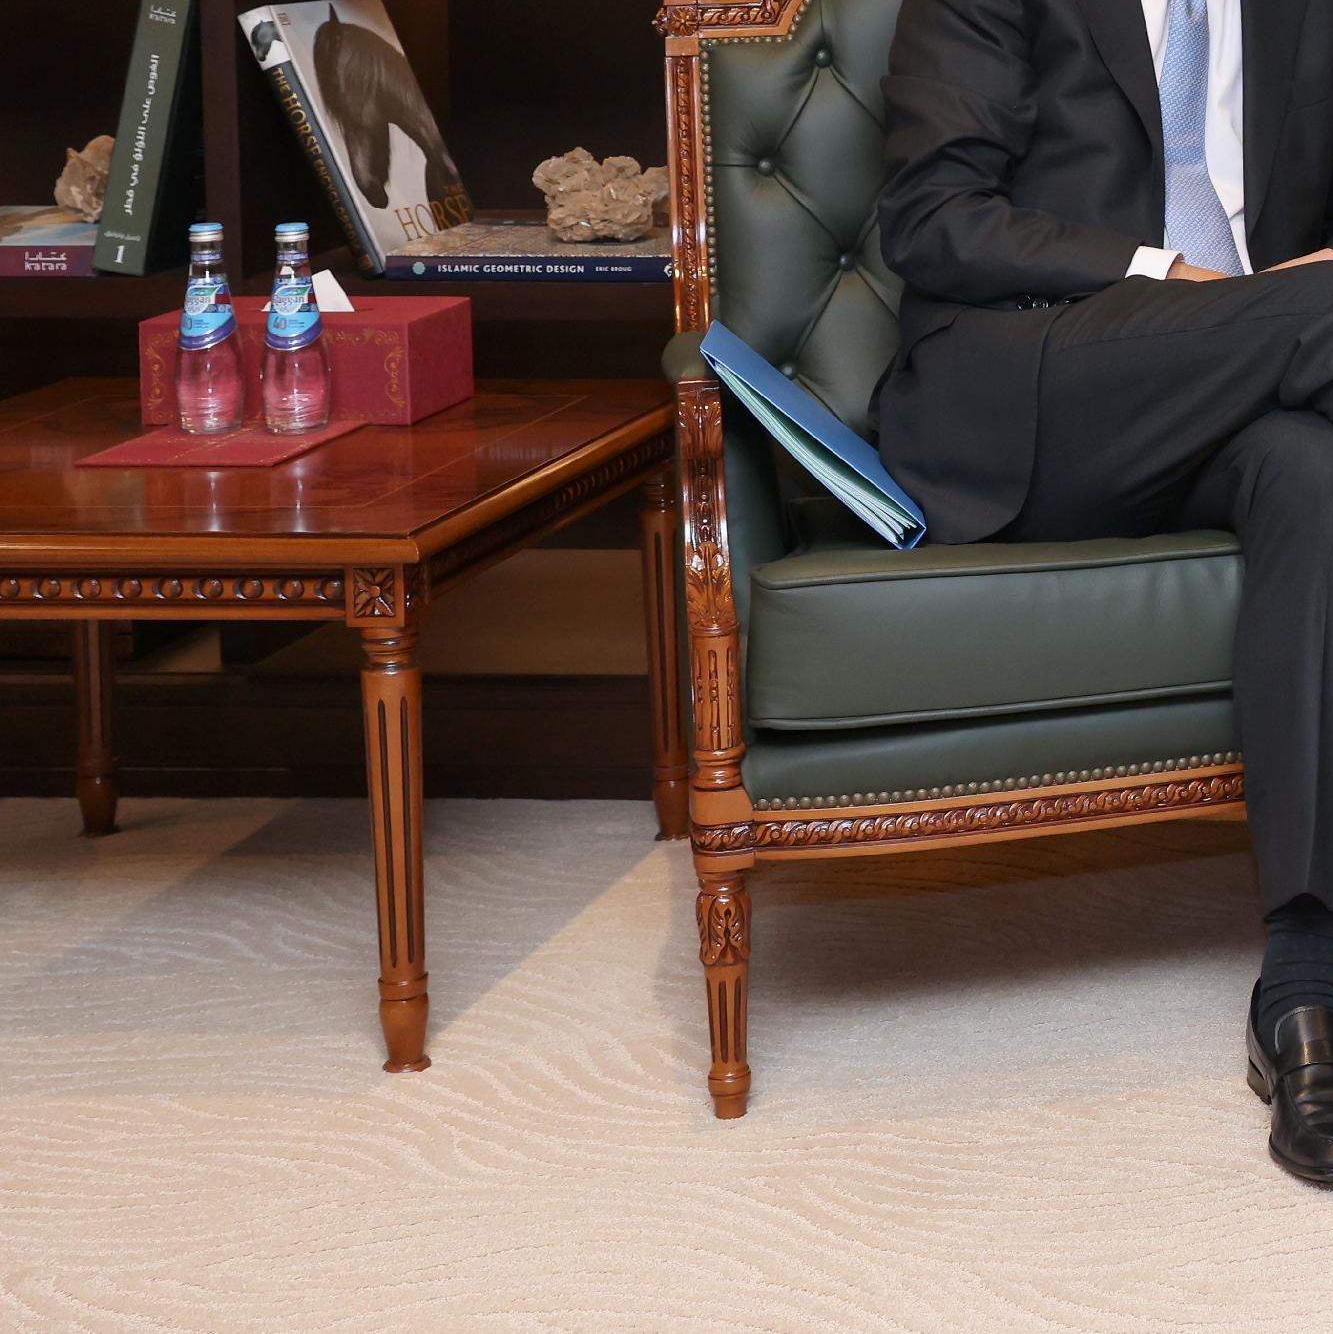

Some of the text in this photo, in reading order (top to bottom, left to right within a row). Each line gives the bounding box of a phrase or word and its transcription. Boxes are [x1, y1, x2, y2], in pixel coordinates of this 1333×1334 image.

[271, 67, 290, 92] THE
[283, 93, 322, 156] HORSE
[394, 193, 473, 242] HORSE
[113, 244, 125, 264] 1
[24, 261, 67, 271] katara
[437, 264, 480, 273] ISLAMIC
[482, 264, 543, 273] GEOMETRIC
[546, 265, 585, 274] DESIGN
